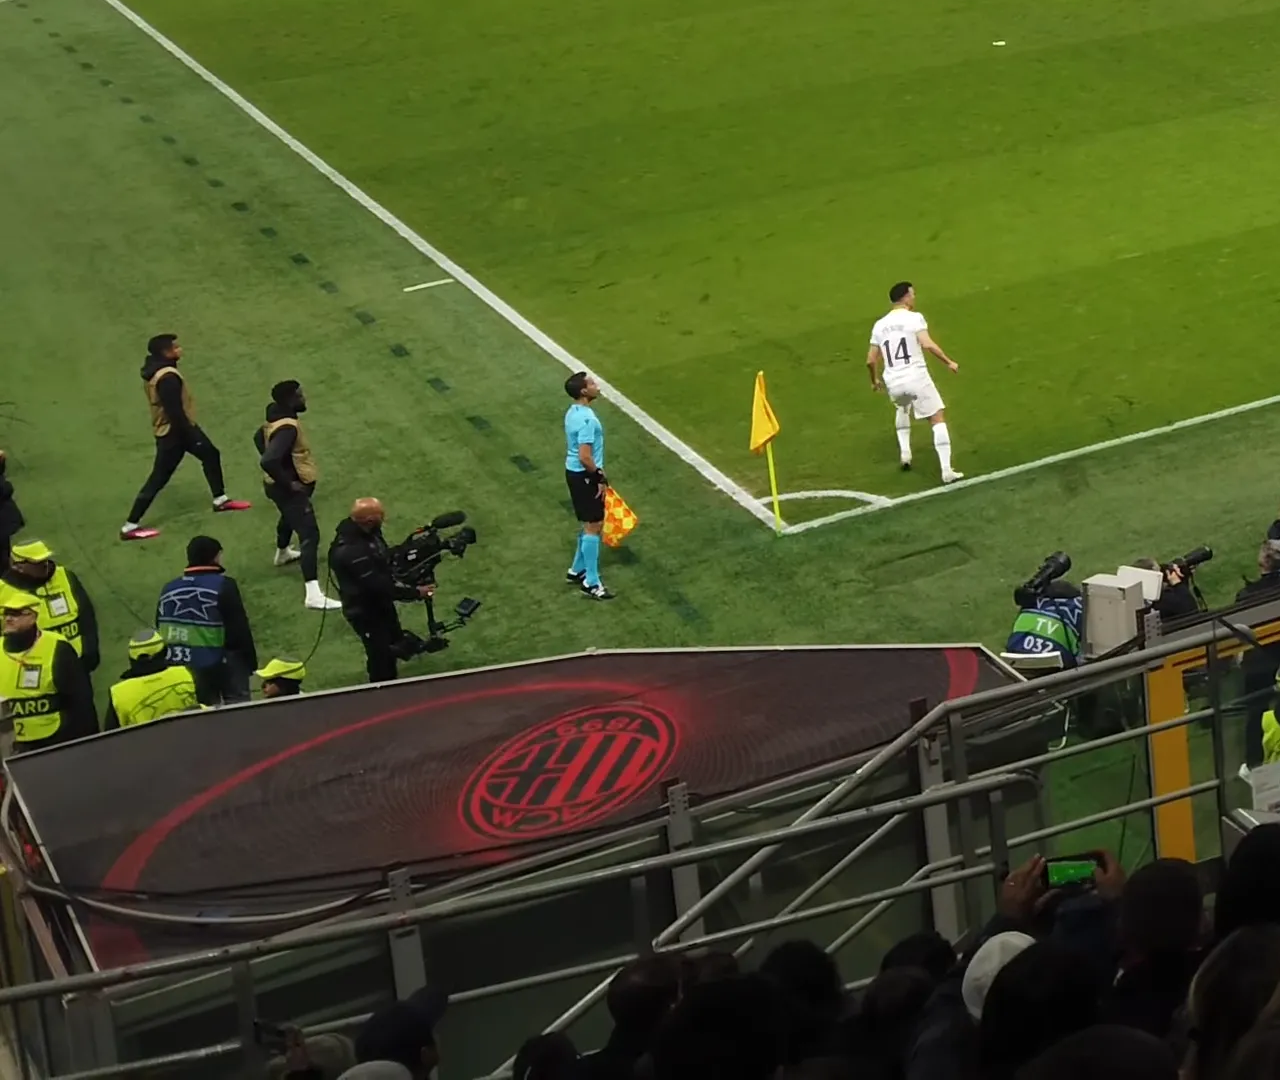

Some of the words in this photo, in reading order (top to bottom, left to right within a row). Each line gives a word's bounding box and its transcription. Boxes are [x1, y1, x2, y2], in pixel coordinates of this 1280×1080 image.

[883, 336, 912, 368] 14
[1036, 617, 1060, 635] TV
[1023, 635, 1054, 654] 032
